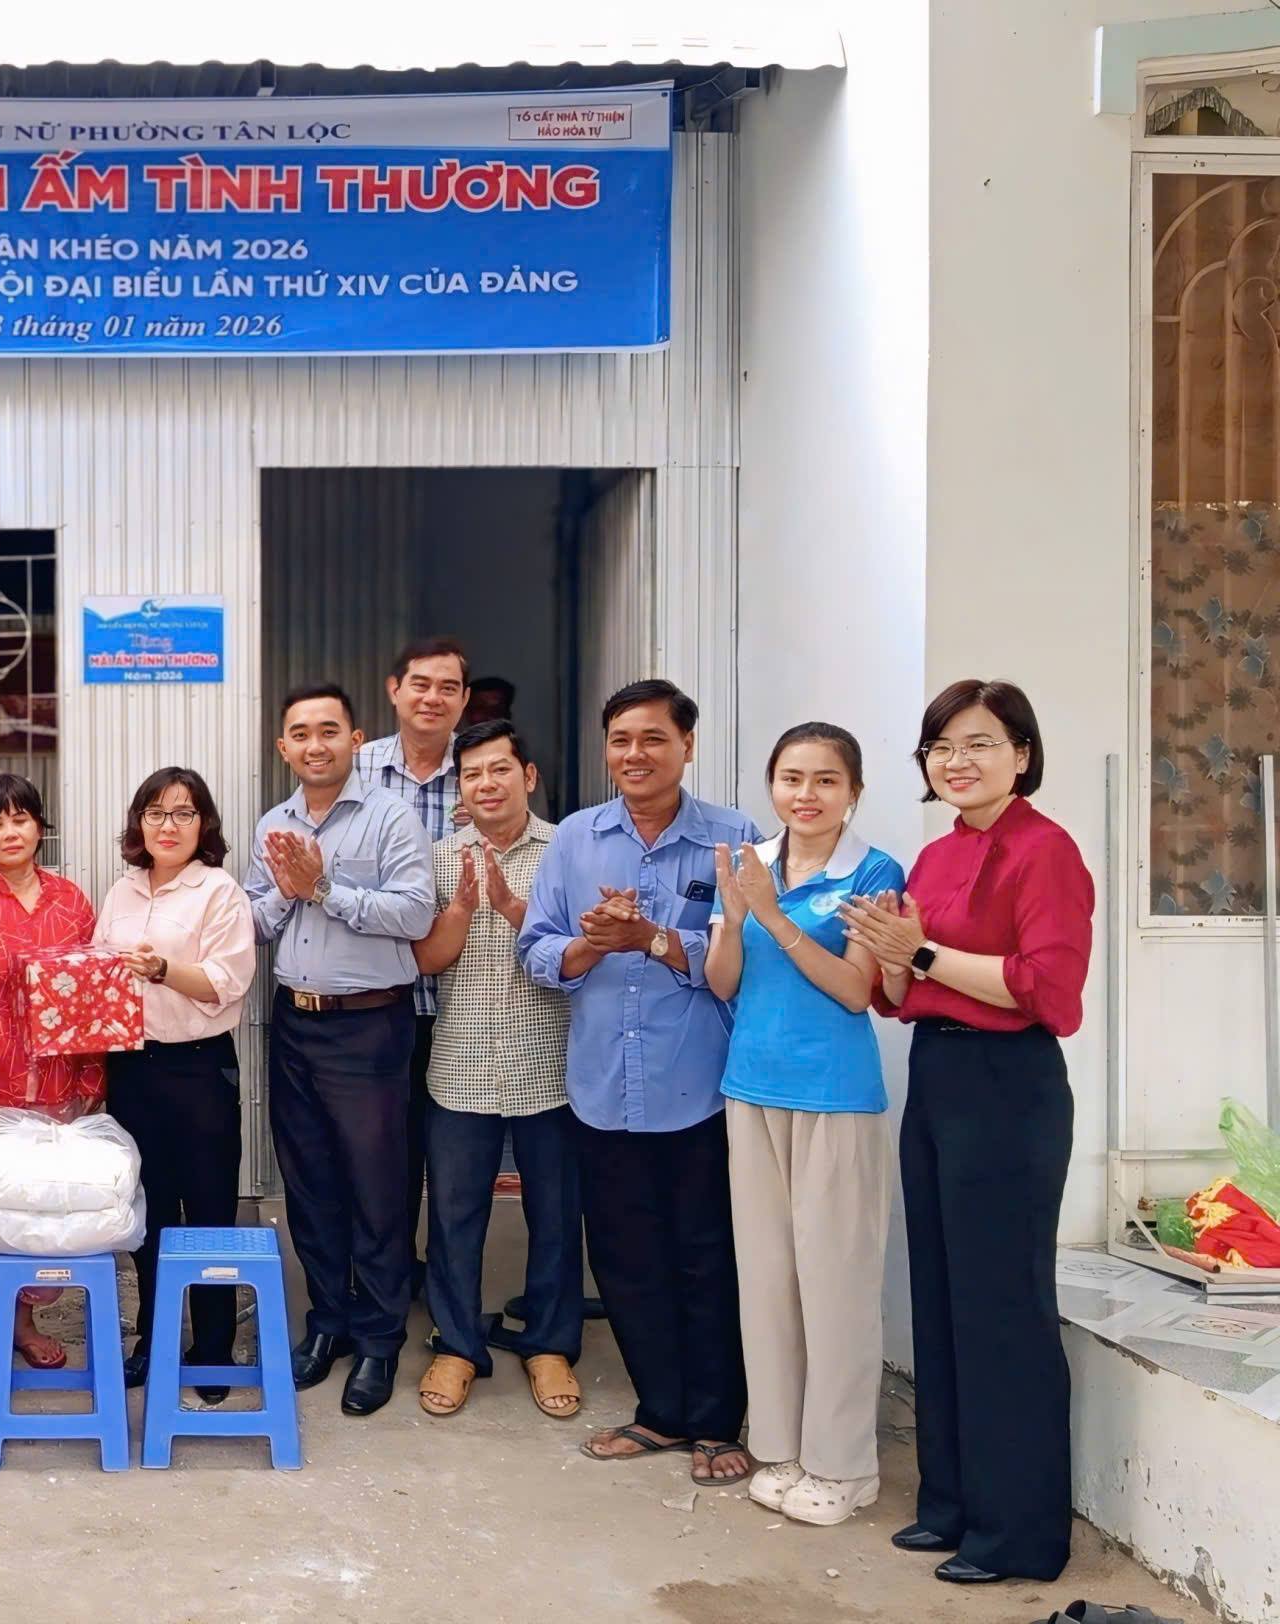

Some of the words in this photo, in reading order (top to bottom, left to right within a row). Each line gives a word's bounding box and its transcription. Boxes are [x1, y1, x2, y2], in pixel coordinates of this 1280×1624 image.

[14, 121, 62, 141] NỮ
[70, 120, 205, 142] PHƯỜNG
[213, 120, 276, 141] TÂN
[20, 149, 129, 213] ẤM
[143, 152, 303, 213] TÌNH
[316, 158, 601, 213] THƯƠNG
[49, 233, 140, 261] KHÉO
[148, 233, 223, 261] NĂM
[231, 238, 309, 261] 2026
[44, 275, 102, 304] ĐẠI
[112, 265, 183, 298] BIỂU
[263, 269, 330, 298] THỨ
[336, 274, 391, 297] XIV
[399, 266, 470, 295] CỦA
[479, 264, 579, 294] ĐẢNG
[12, 314, 93, 342] tháng
[103, 315, 135, 338] 01
[144, 316, 206, 338] năm
[214, 315, 283, 338] 2026
